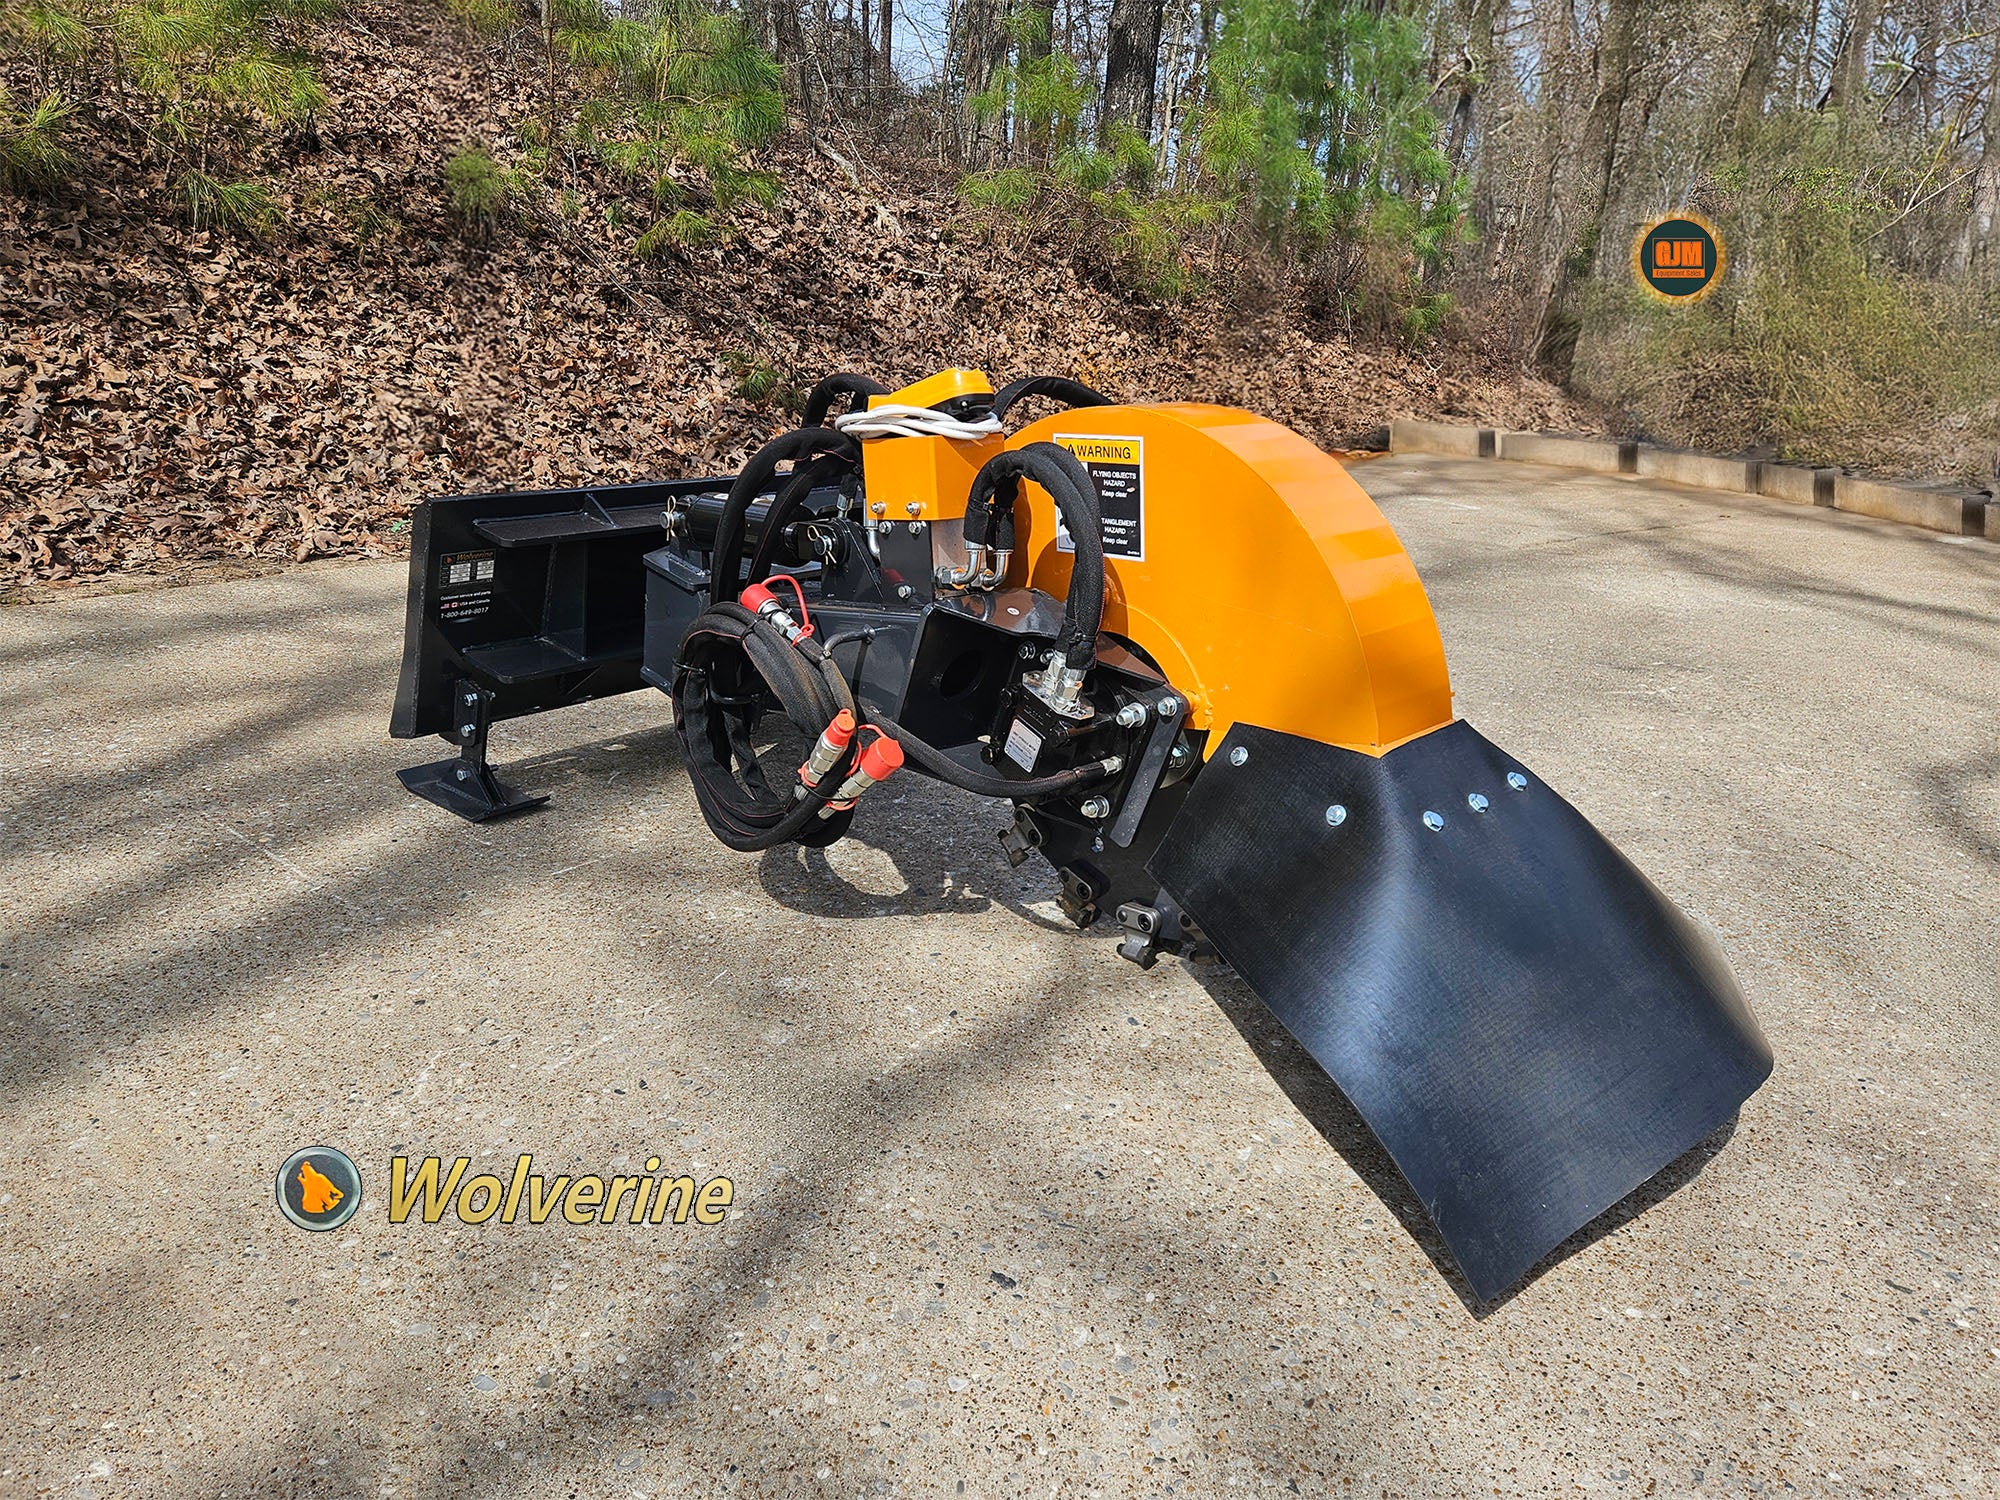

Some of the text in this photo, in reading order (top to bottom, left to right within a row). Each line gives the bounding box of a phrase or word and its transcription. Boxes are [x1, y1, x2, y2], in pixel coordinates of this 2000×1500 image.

[1077, 445, 1131, 459] WARNING
[1092, 470, 1137, 480] FLYING OBJECTS
[1102, 490, 1114, 498] Keep
[1101, 518, 1137, 527] TANGLEMENT
[1103, 536, 1115, 545] Keep
